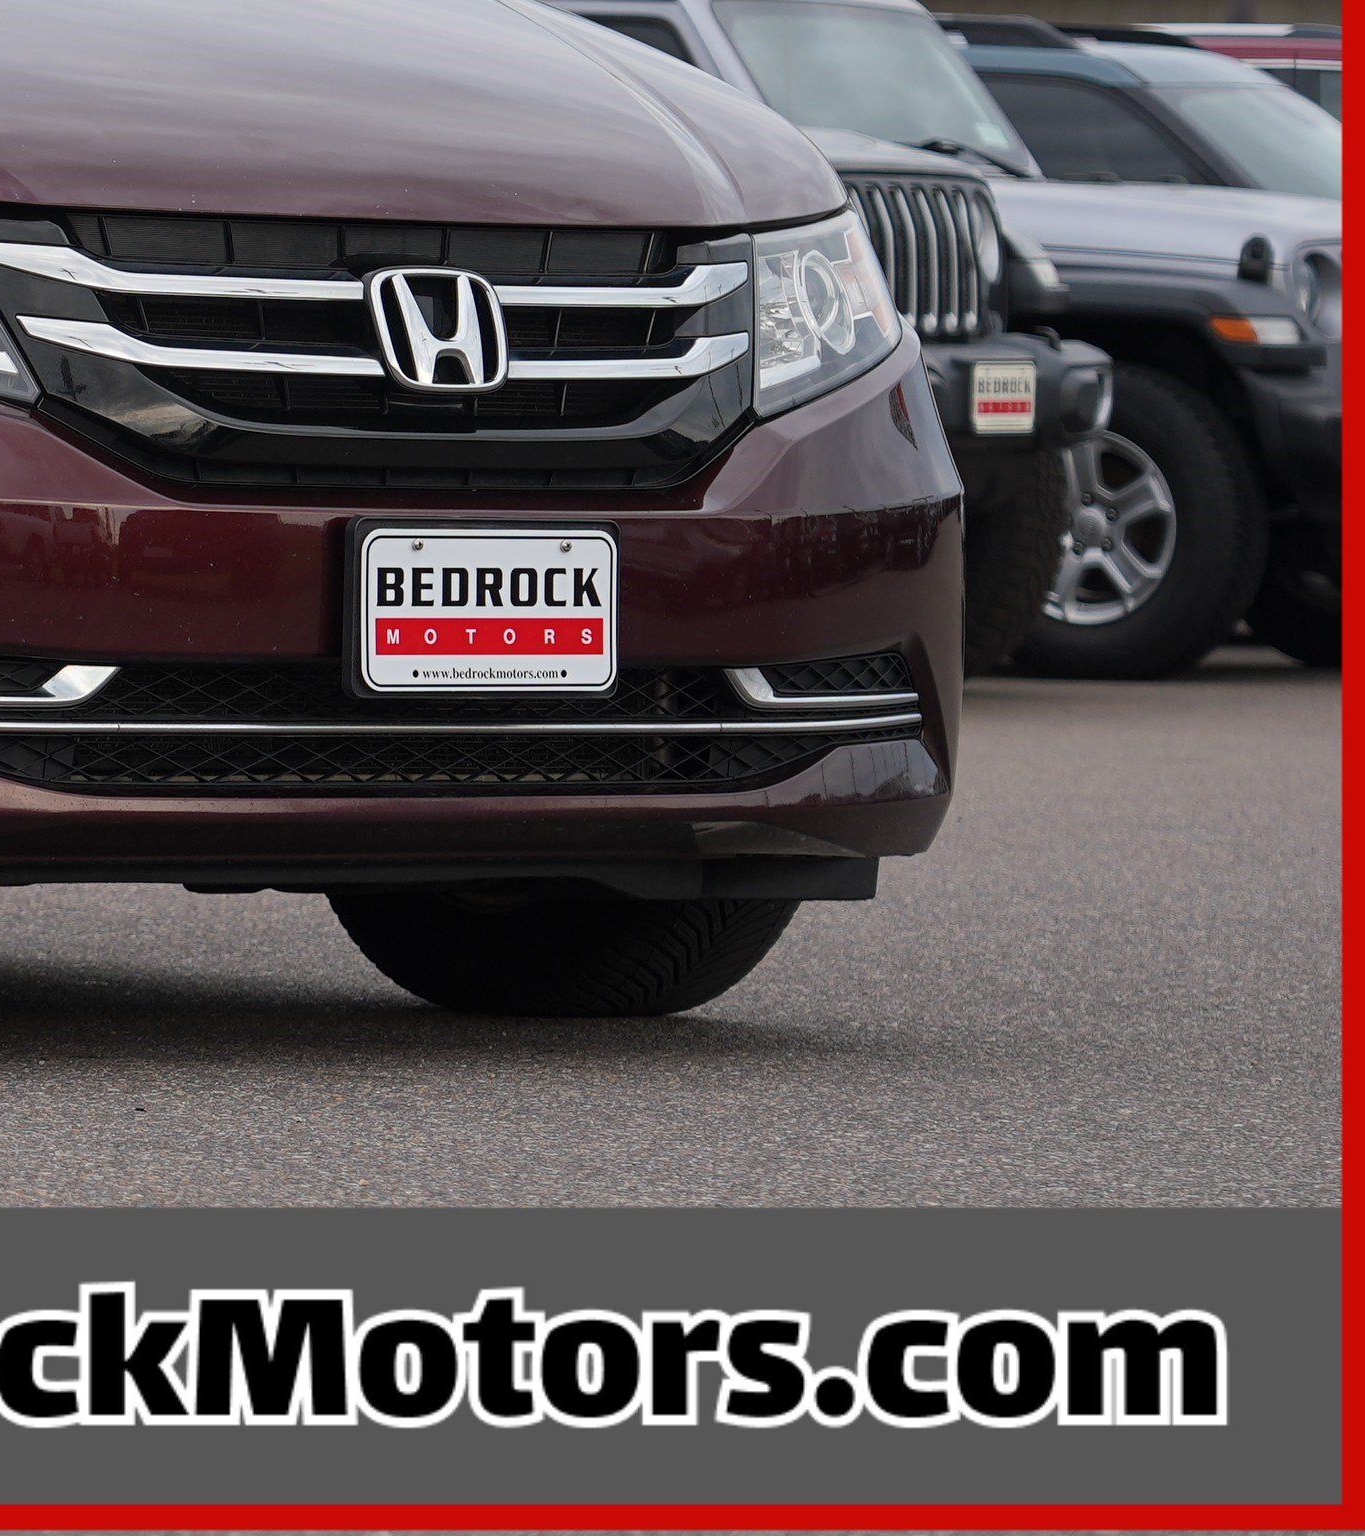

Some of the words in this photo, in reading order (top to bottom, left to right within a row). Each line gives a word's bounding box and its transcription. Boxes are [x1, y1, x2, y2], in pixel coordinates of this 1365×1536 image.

[978, 377, 1031, 394] BEDROCK
[376, 567, 602, 607] BEDROCK
[386, 628, 593, 645] MOTORS
[422, 667, 559, 680] www.bedrockmotors.com
